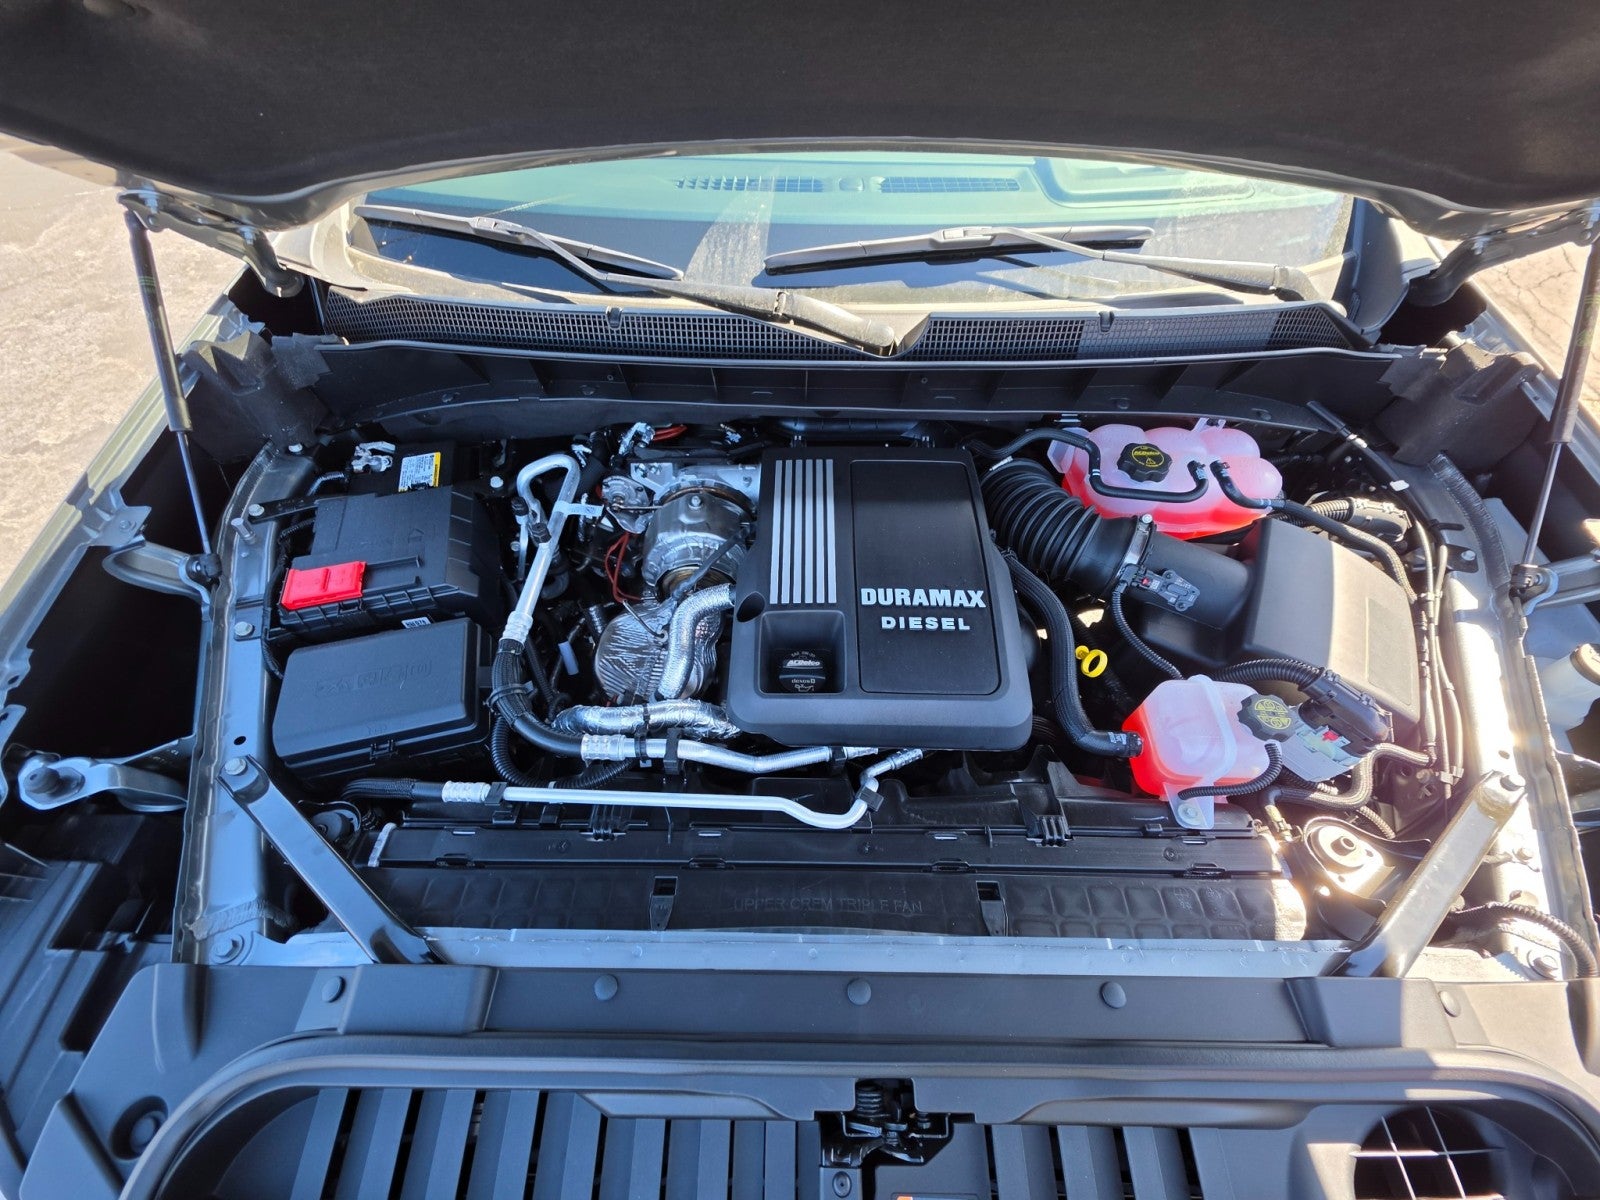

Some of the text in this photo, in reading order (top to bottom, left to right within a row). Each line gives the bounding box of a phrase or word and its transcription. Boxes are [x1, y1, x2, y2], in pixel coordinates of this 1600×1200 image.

[861, 588, 986, 608] DURAMAX
[881, 616, 970, 630] DIESEL
[786, 659, 821, 667] ACDelco
[733, 898, 786, 912] UPPER
[838, 898, 889, 912] TRIPLE
[894, 899, 923, 913] FAN
